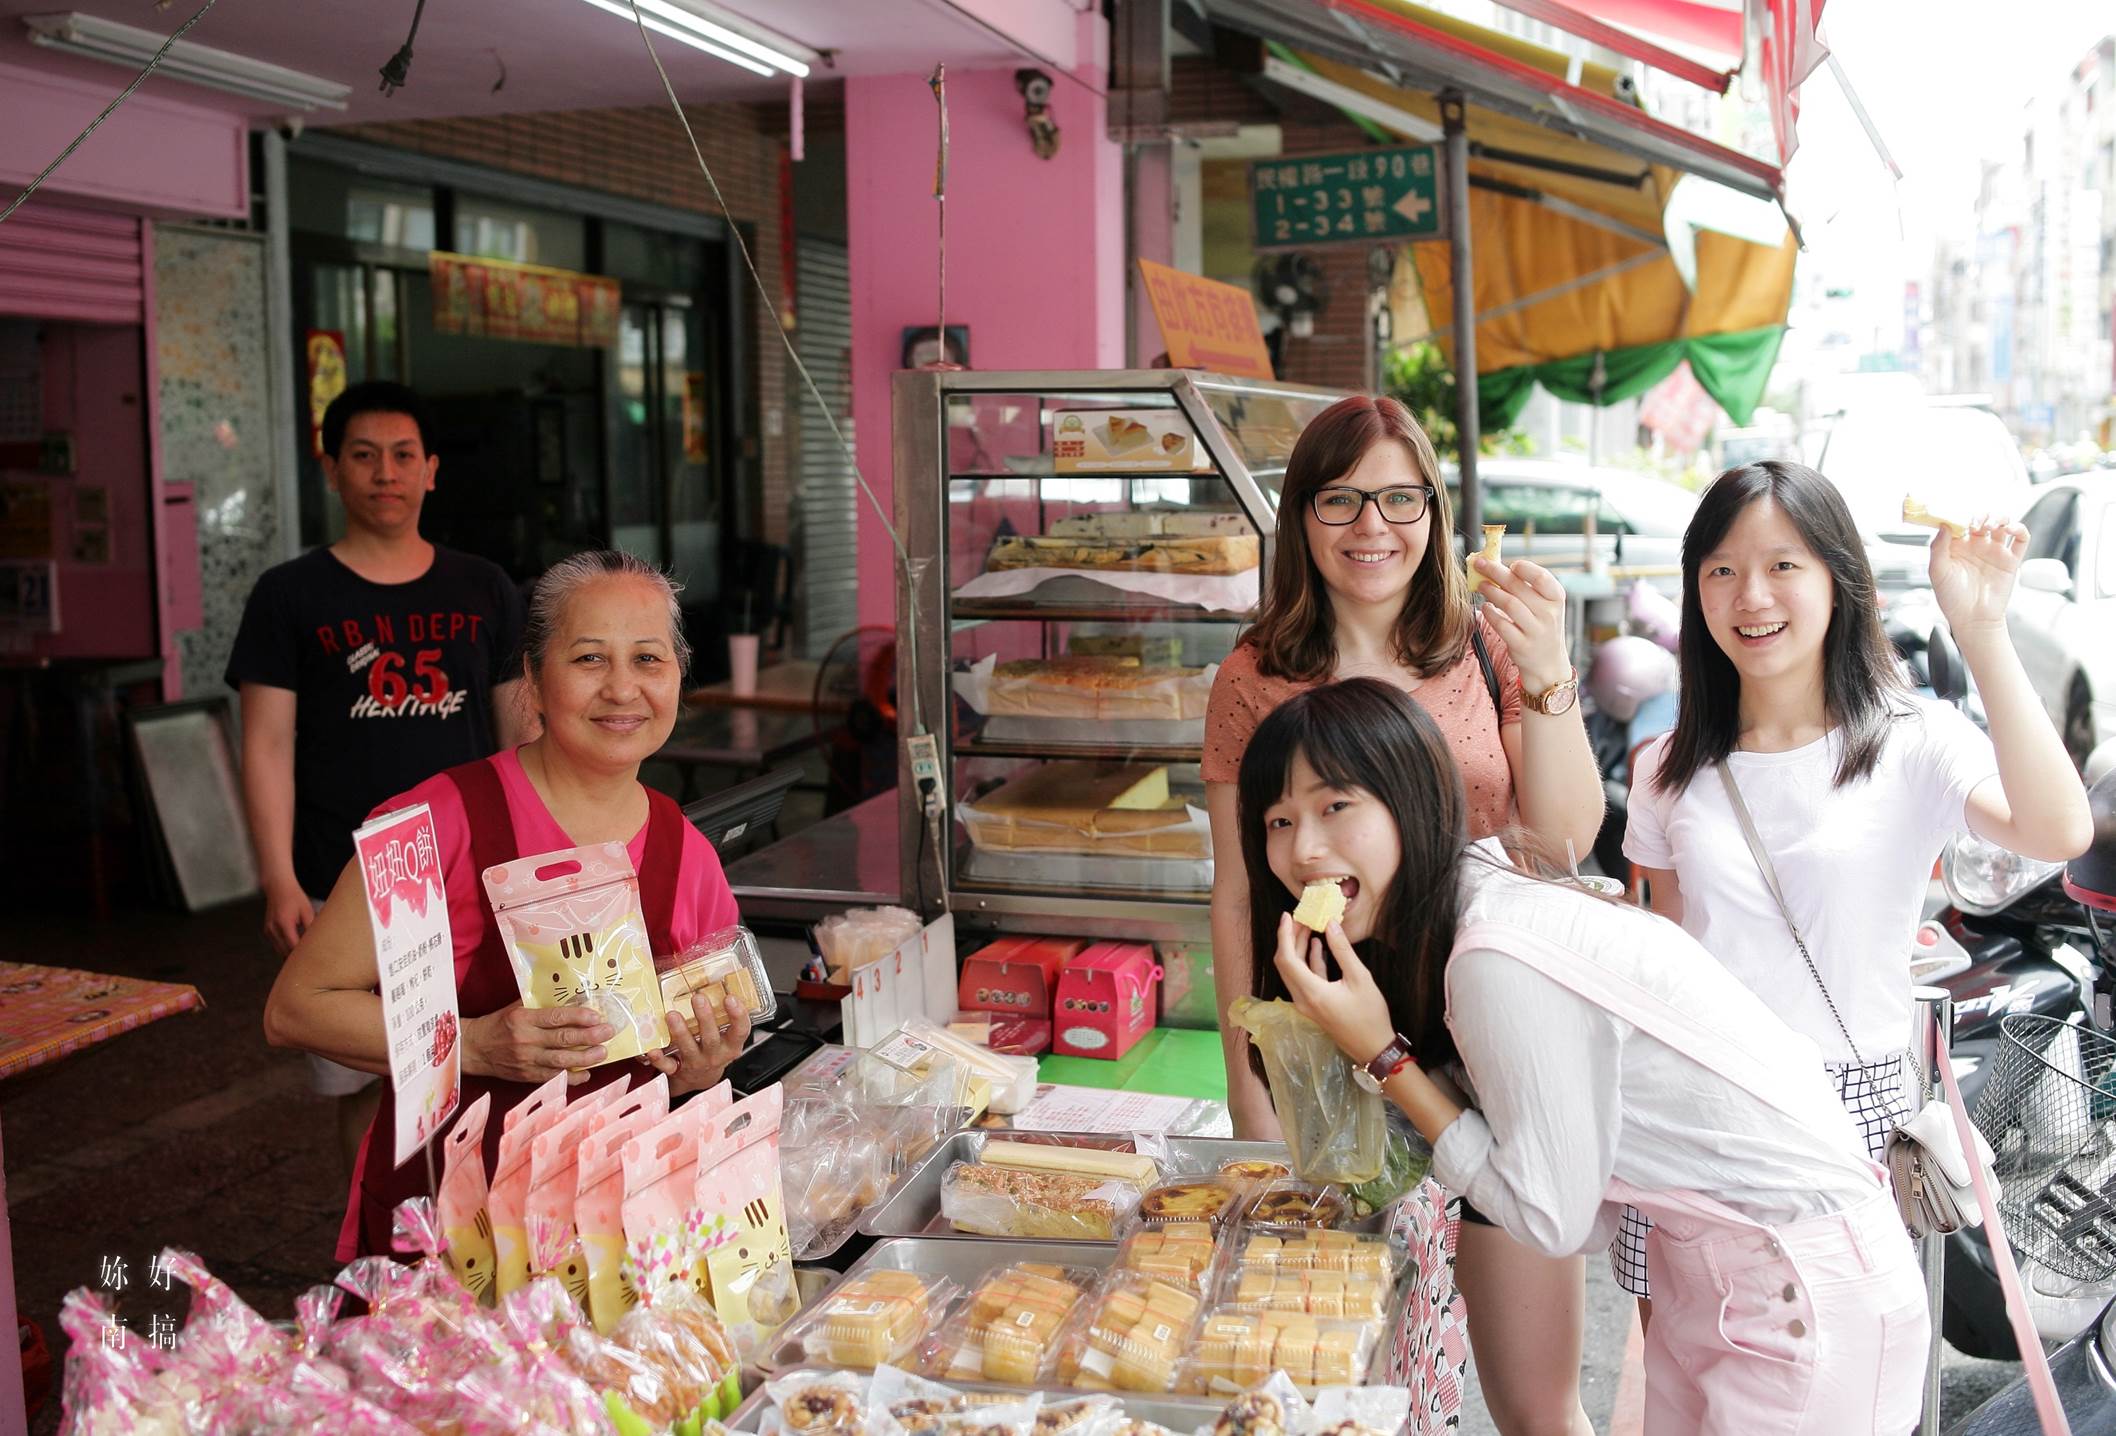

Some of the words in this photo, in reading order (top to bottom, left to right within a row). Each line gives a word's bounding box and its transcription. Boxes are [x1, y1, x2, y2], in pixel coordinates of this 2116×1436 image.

[408, 611, 481, 643] DEPT
[368, 648, 449, 708] 65
[923, 932, 929, 954] 1
[895, 950, 901, 975] 2
[856, 975, 864, 1000] 4
[874, 967, 881, 992] 3
